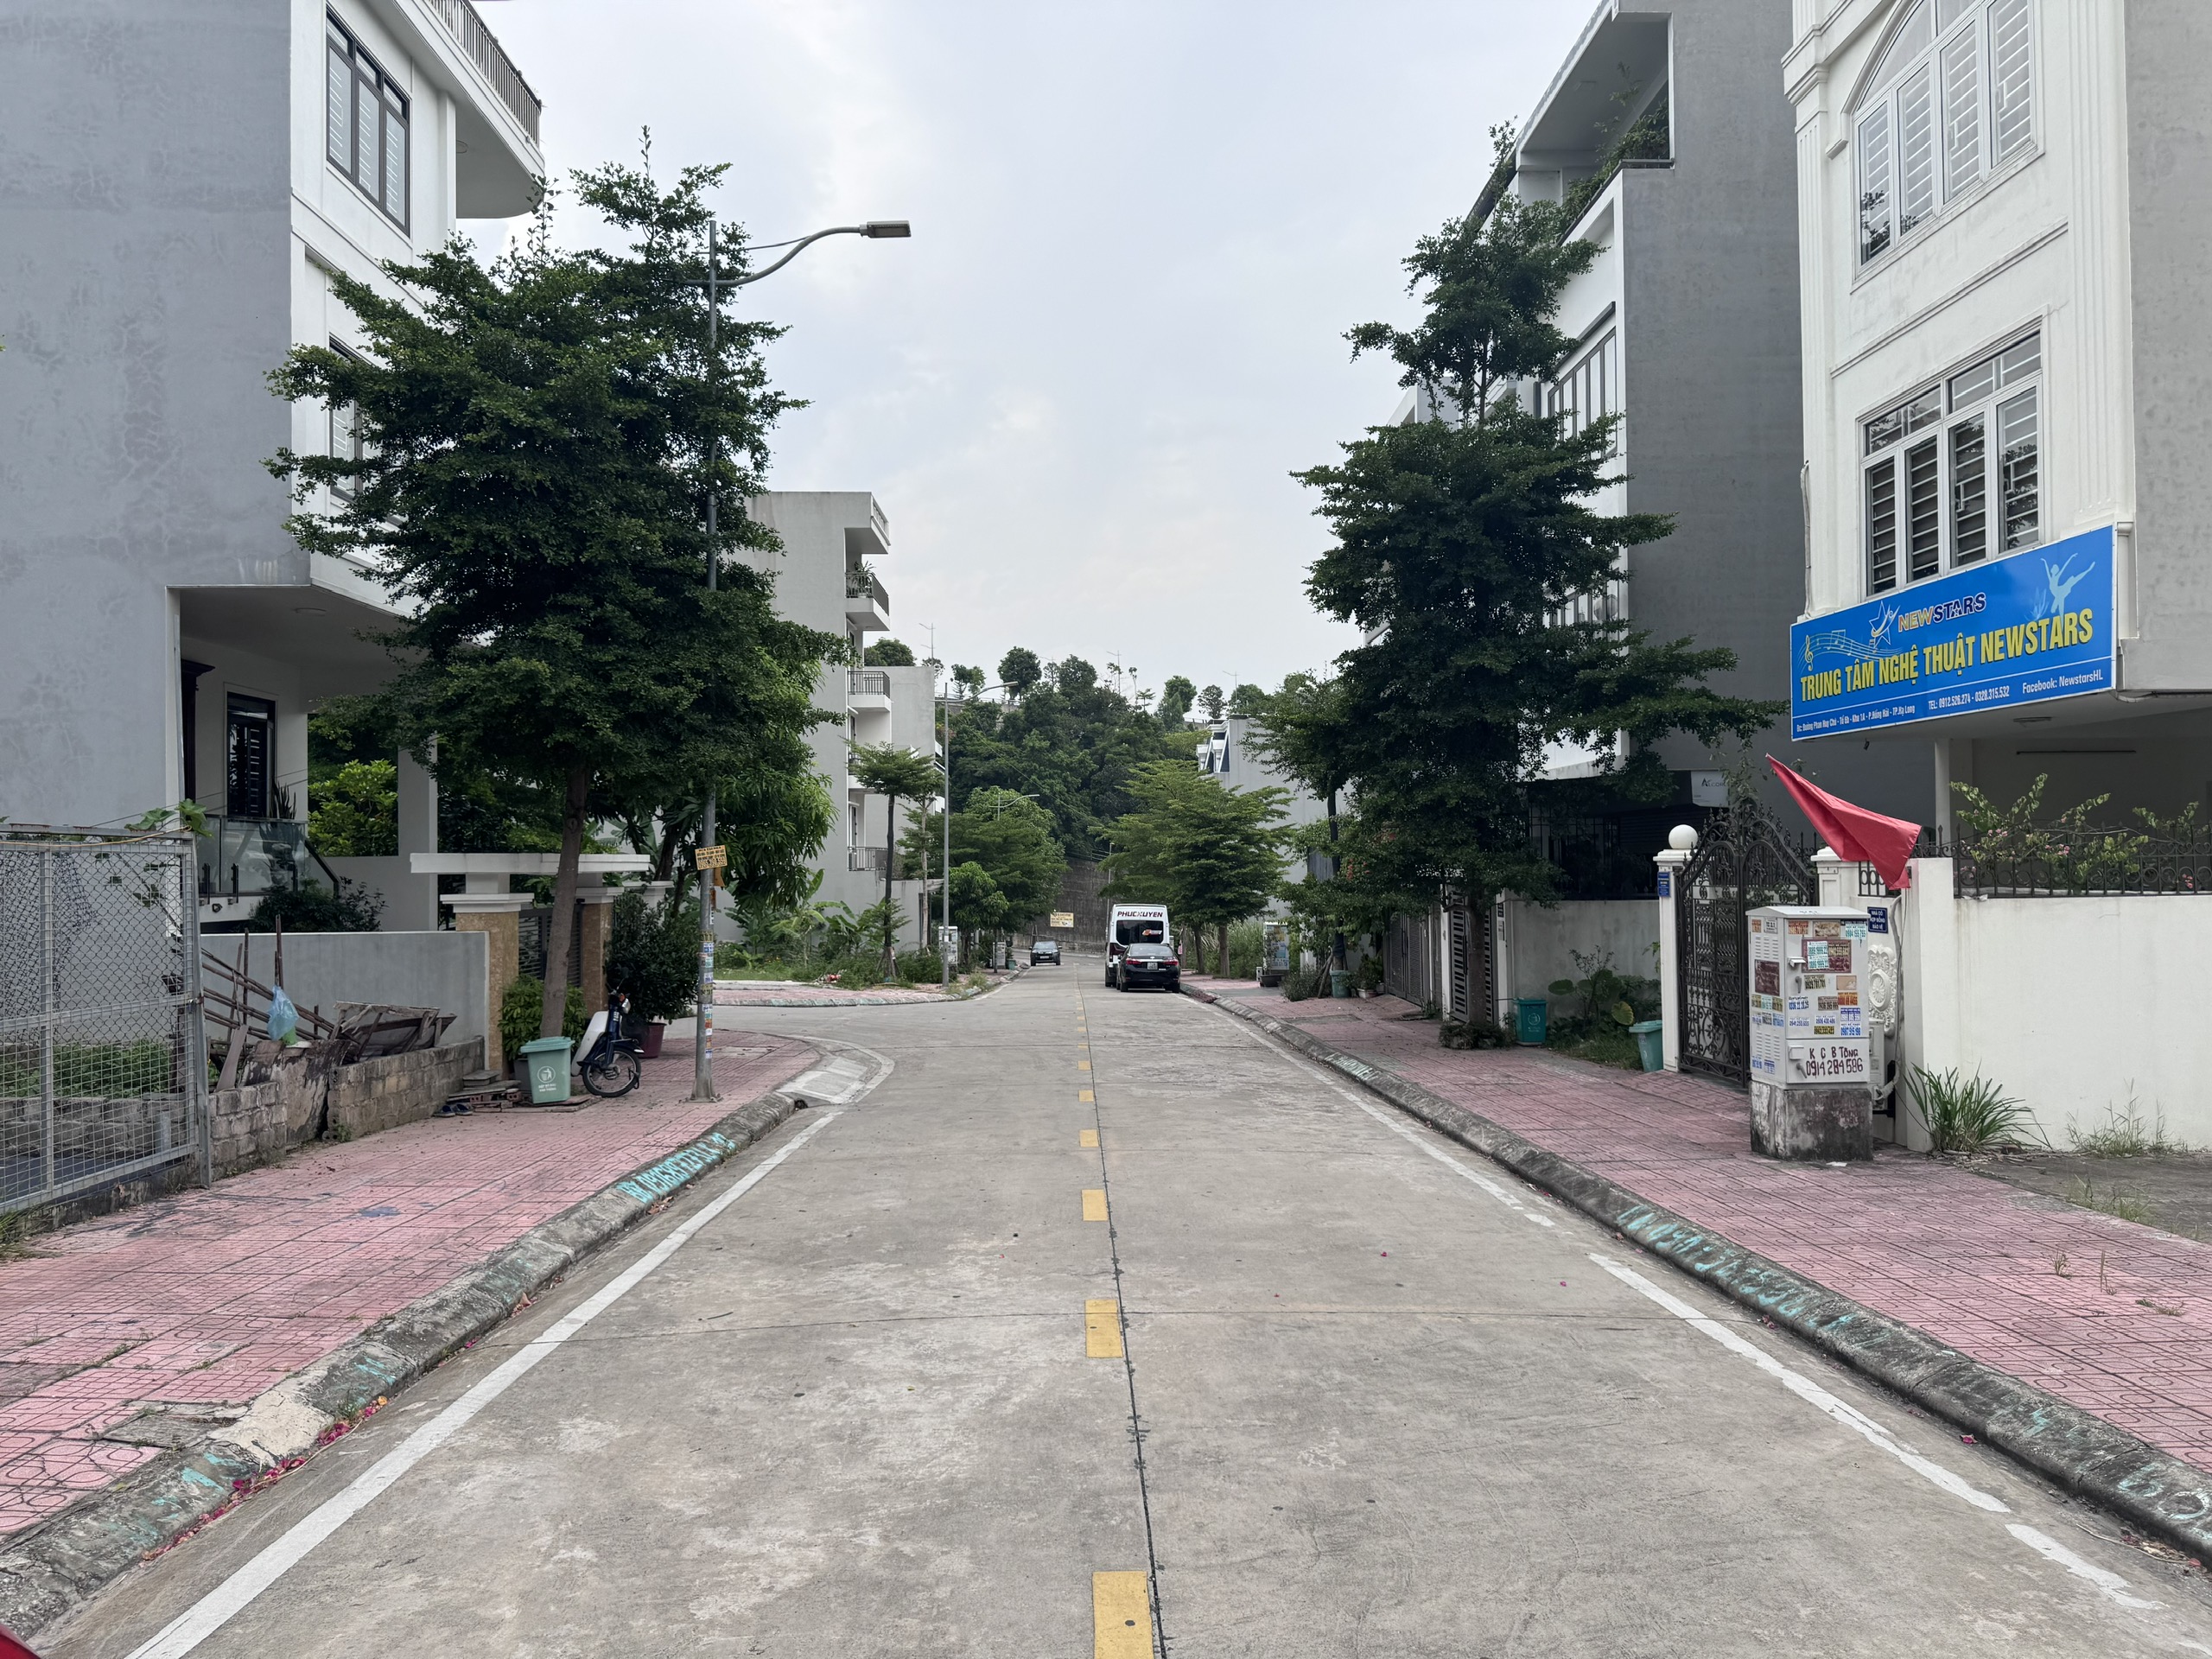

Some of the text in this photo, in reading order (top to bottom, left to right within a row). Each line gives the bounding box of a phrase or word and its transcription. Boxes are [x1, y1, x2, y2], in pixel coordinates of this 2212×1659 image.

[1898, 592, 1986, 632] NEWSTARS
[1800, 608, 2094, 702] TRUNG TÂM NGHỆ THUẬT NEWSTARS
[2022, 669, 2104, 694] Facebook: NewstarsHL
[1929, 700, 1937, 710] TEL:
